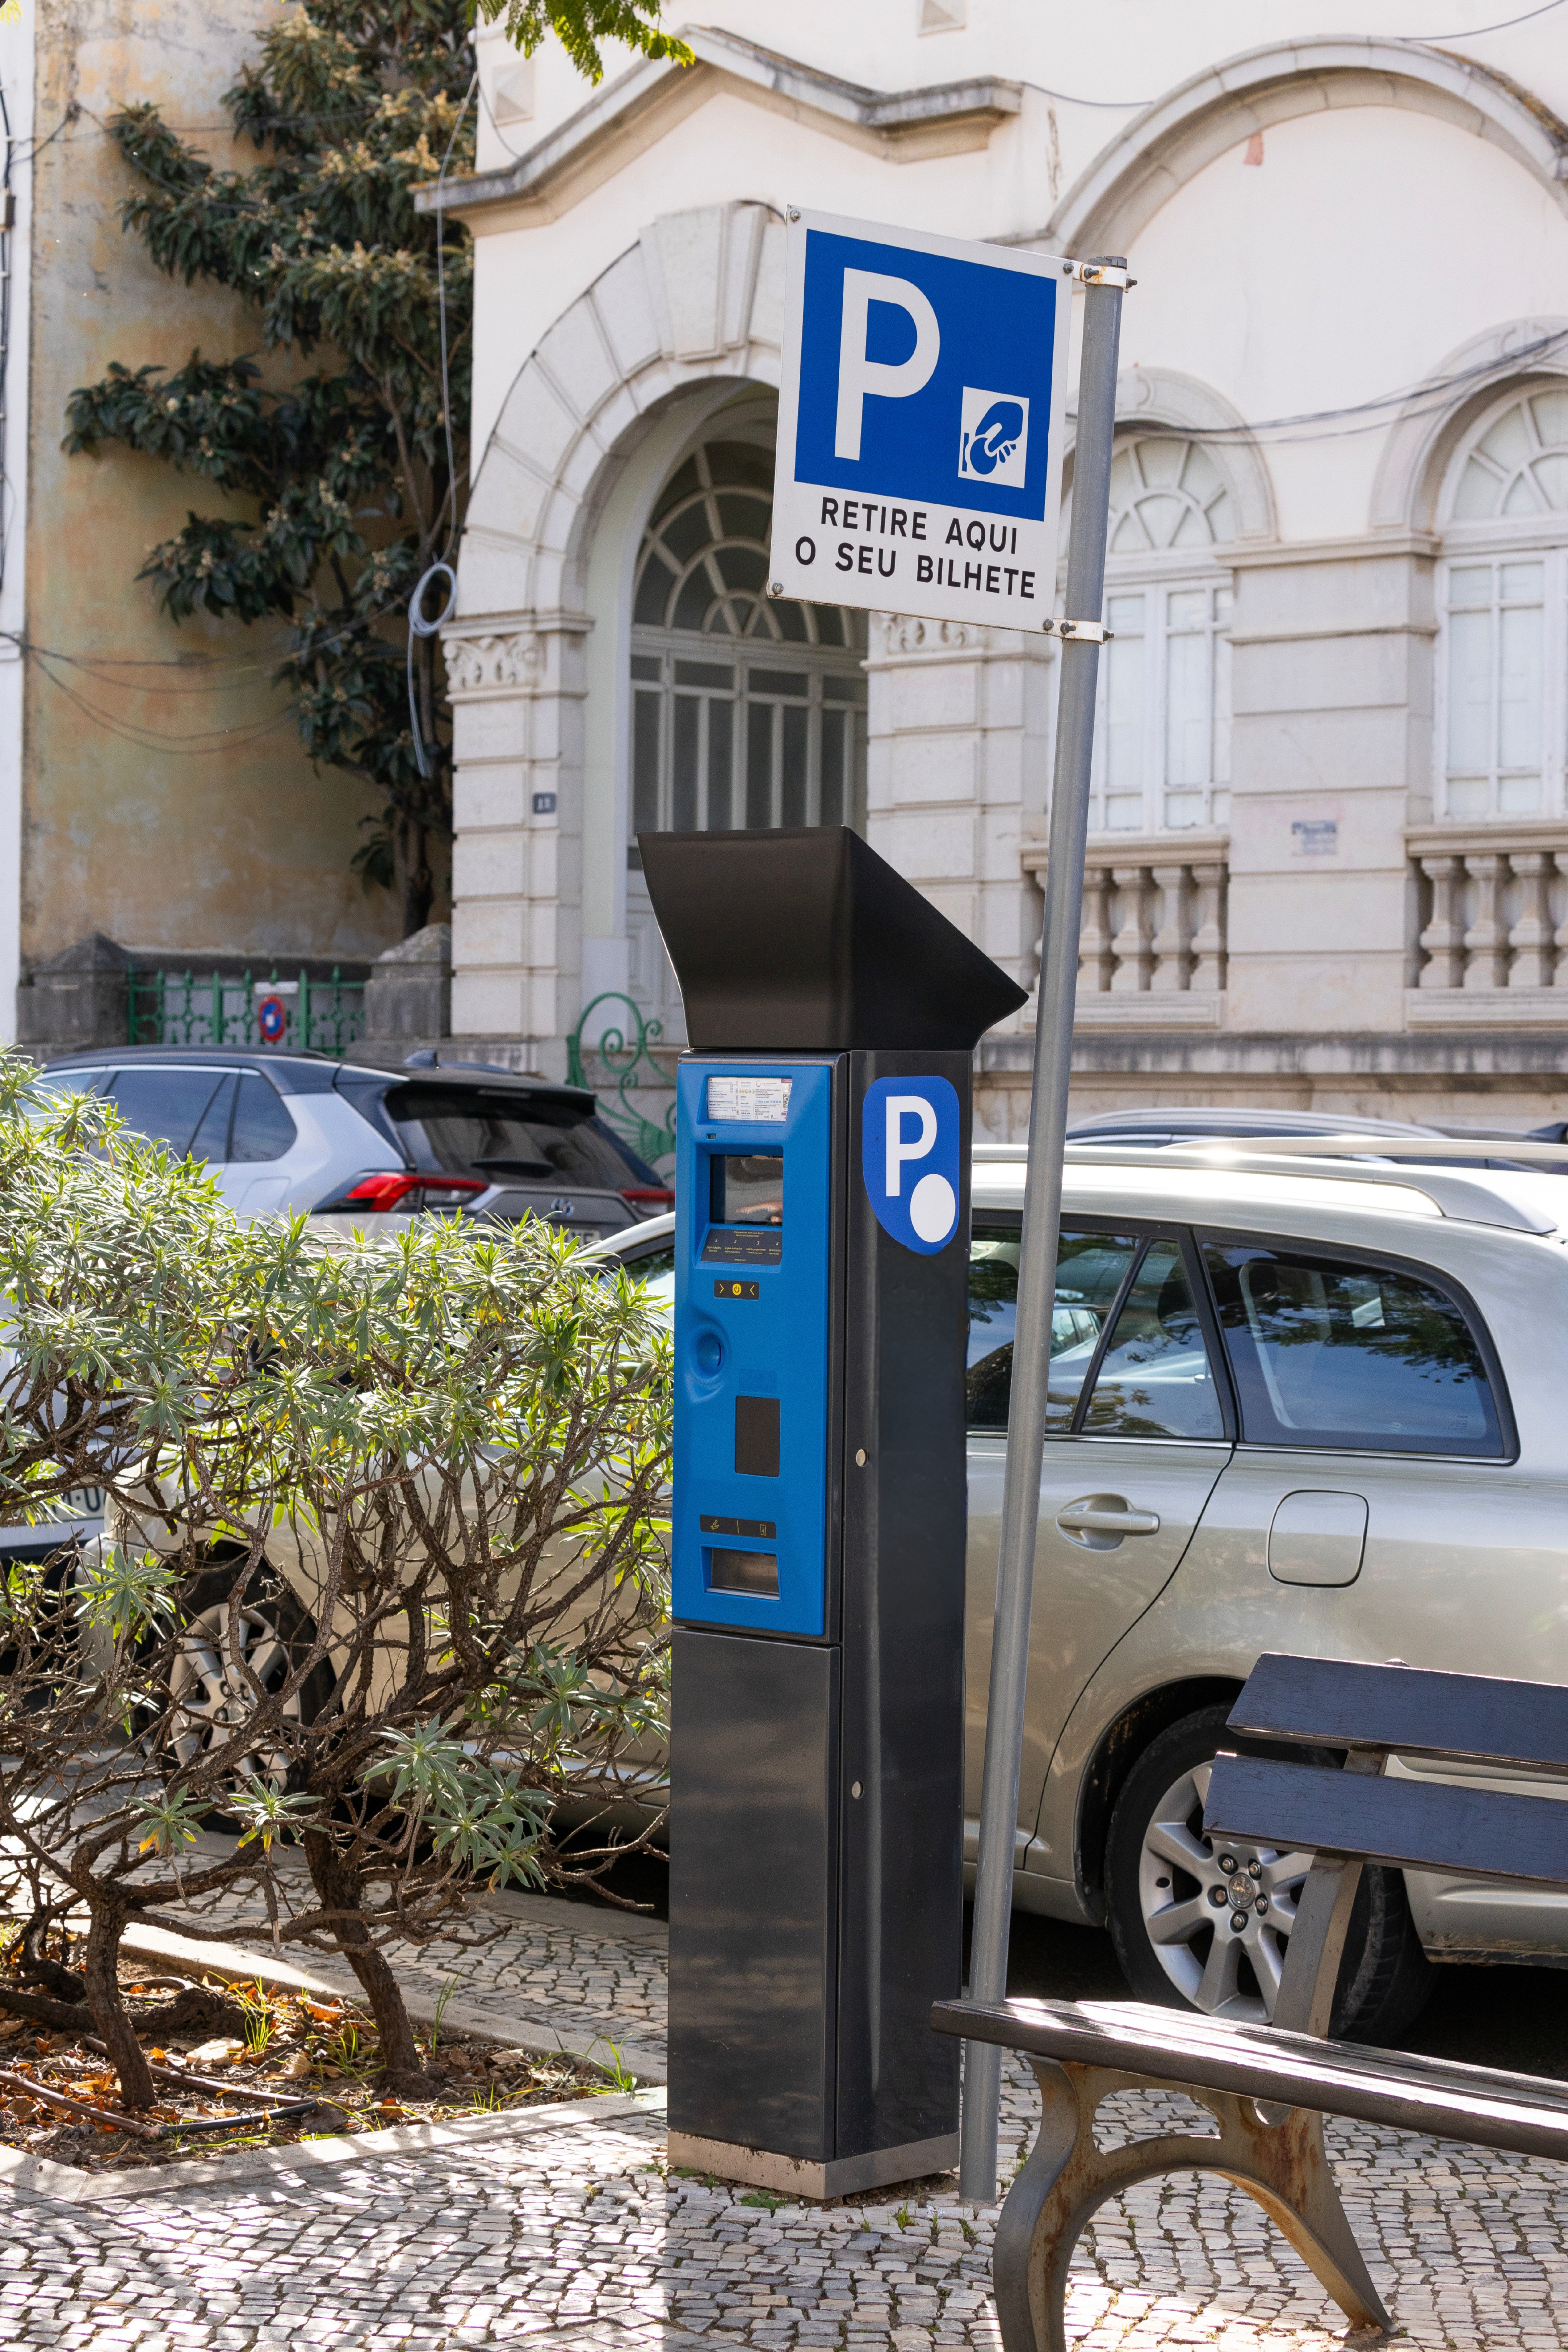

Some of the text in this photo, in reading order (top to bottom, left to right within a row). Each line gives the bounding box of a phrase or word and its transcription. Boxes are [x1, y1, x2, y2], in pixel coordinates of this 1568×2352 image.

[834, 267, 940, 461] P
[821, 497, 1017, 554] RETIRE AQUI
[796, 536, 1035, 599] O SEU BILHETE
[886, 1096, 937, 1197] P
